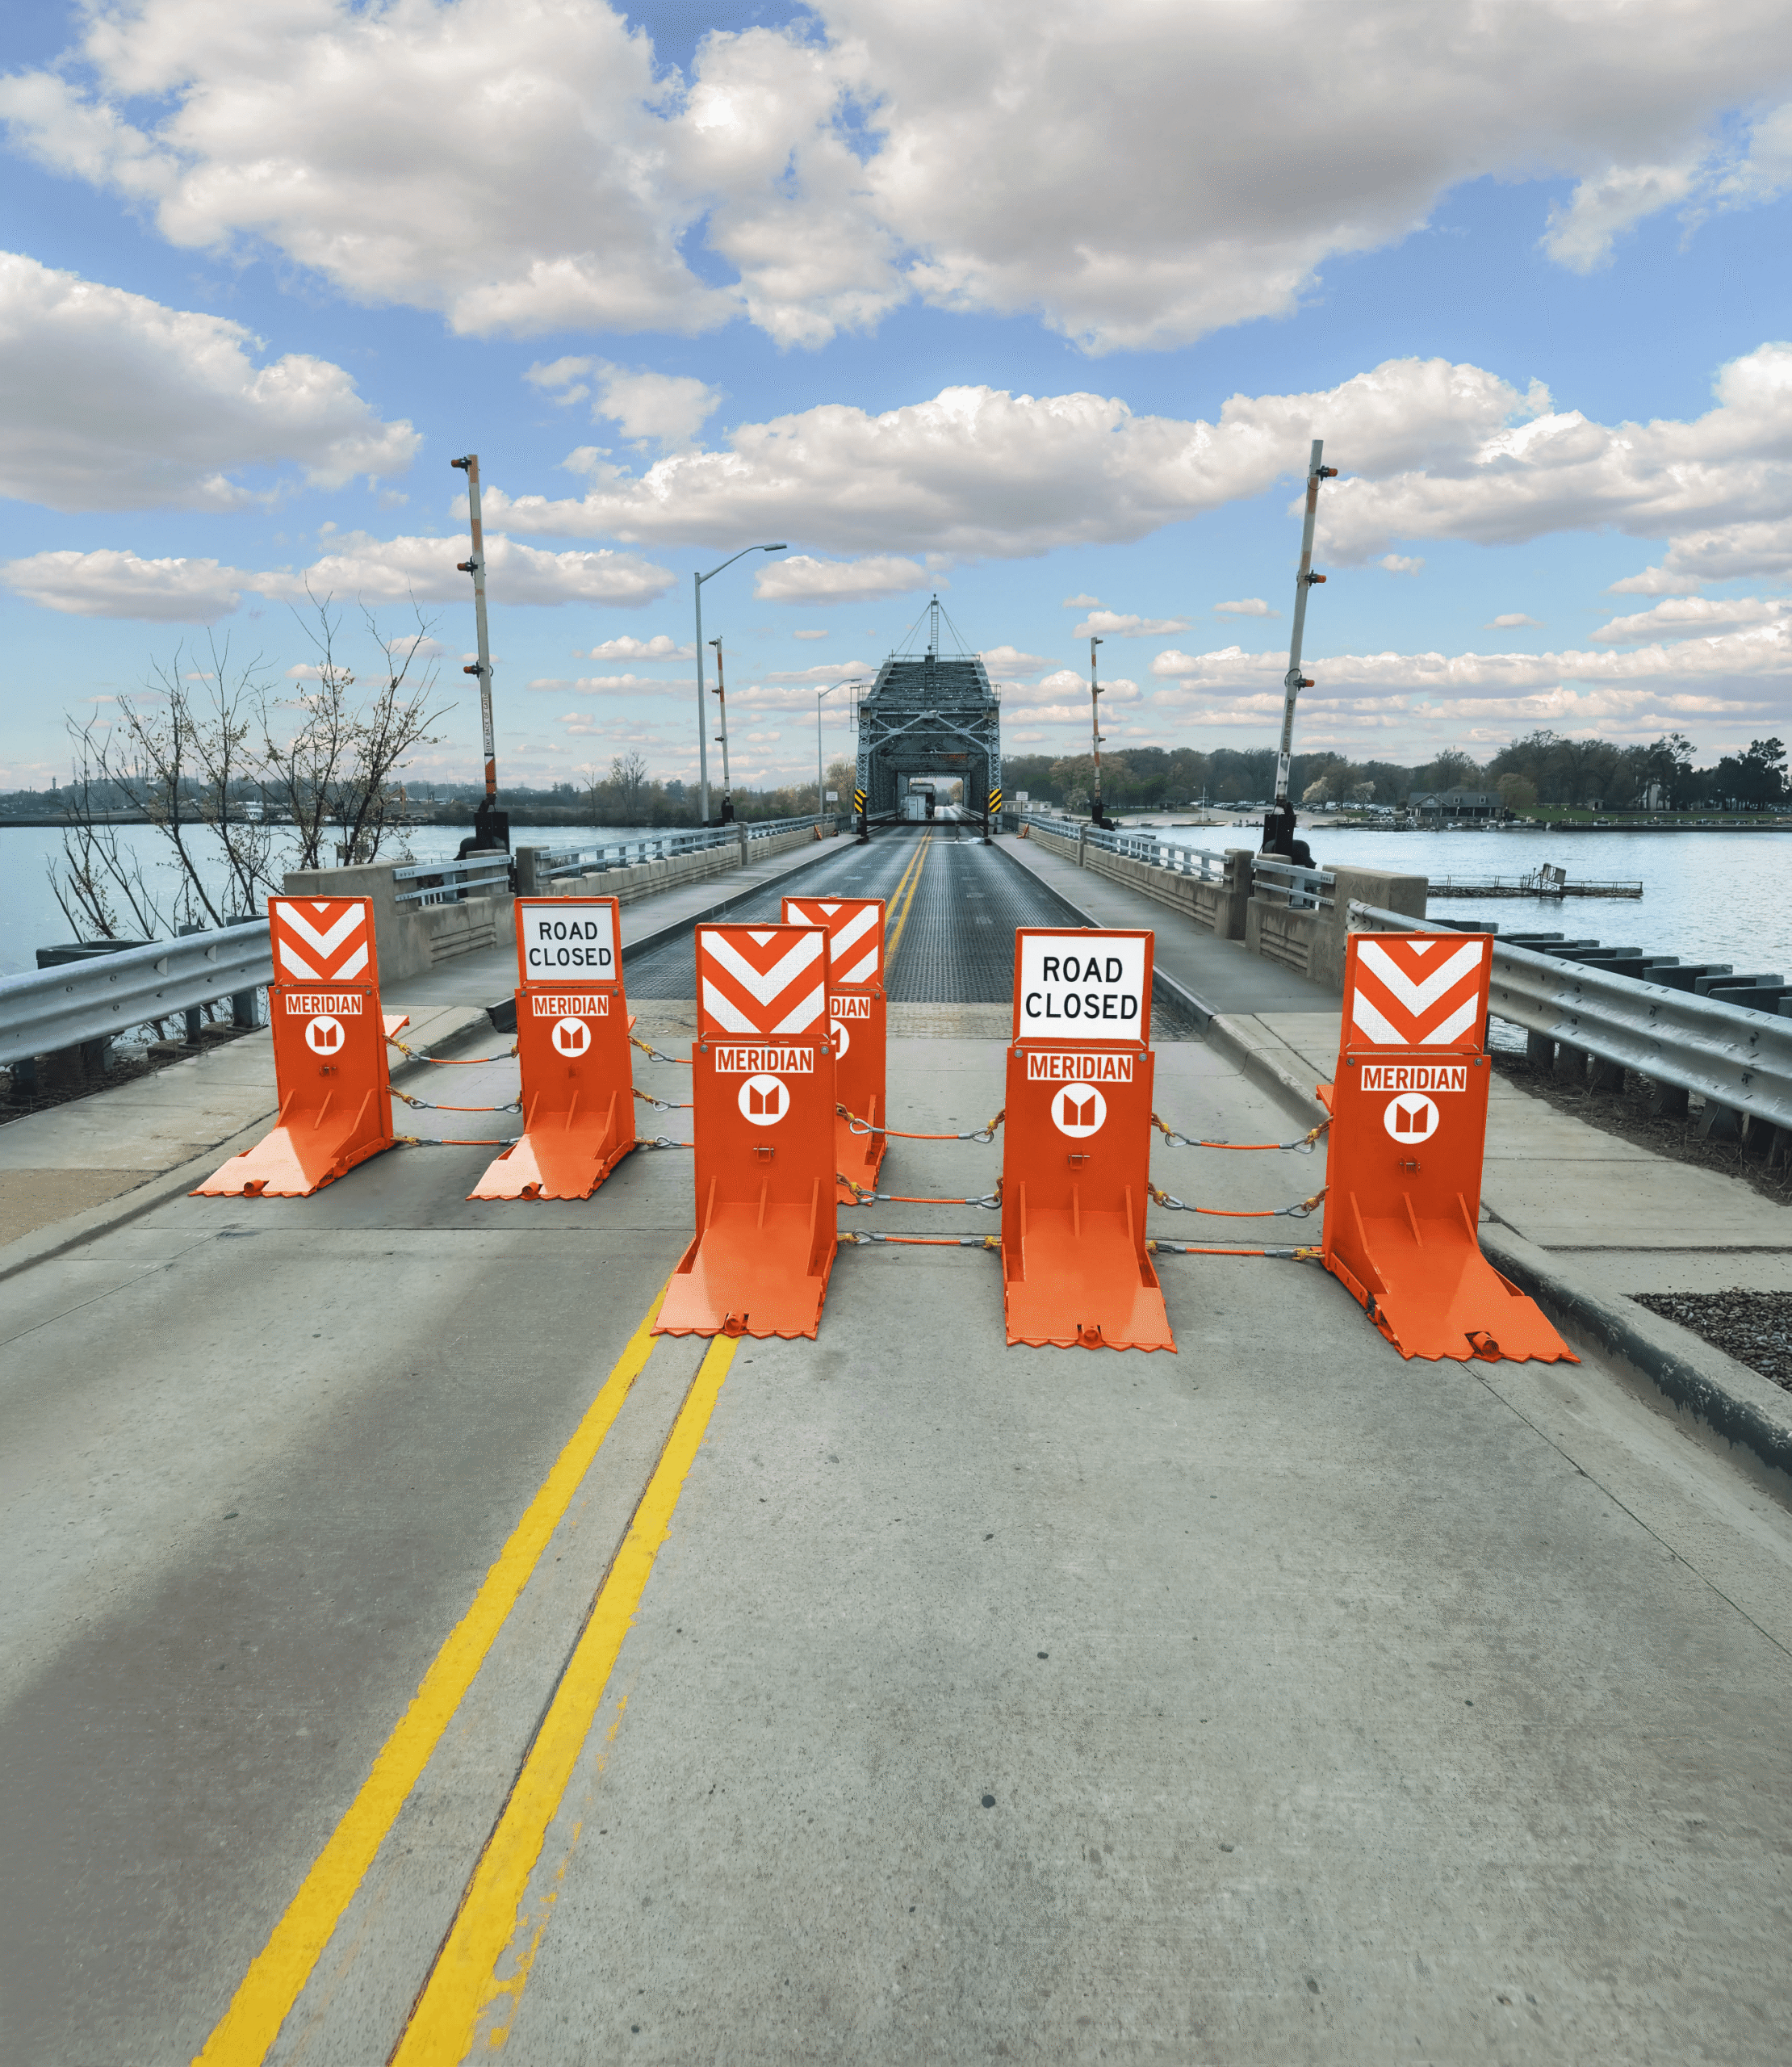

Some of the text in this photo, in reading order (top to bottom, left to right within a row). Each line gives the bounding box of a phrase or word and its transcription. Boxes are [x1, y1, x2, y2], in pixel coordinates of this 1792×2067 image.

[539, 921, 597, 940] ROAD
[529, 947, 611, 966] CLOSED
[1043, 956, 1123, 983] ROAD
[287, 996, 361, 1013] MERIDIAN
[534, 997, 608, 1015] MERIDIAN
[831, 998, 869, 1017] DIAN
[1025, 992, 1138, 1019] CLOSED
[718, 1049, 812, 1071] MERIDIAN
[1030, 1054, 1132, 1080] MERIDIAN
[1363, 1067, 1466, 1090] MERIDIAN
